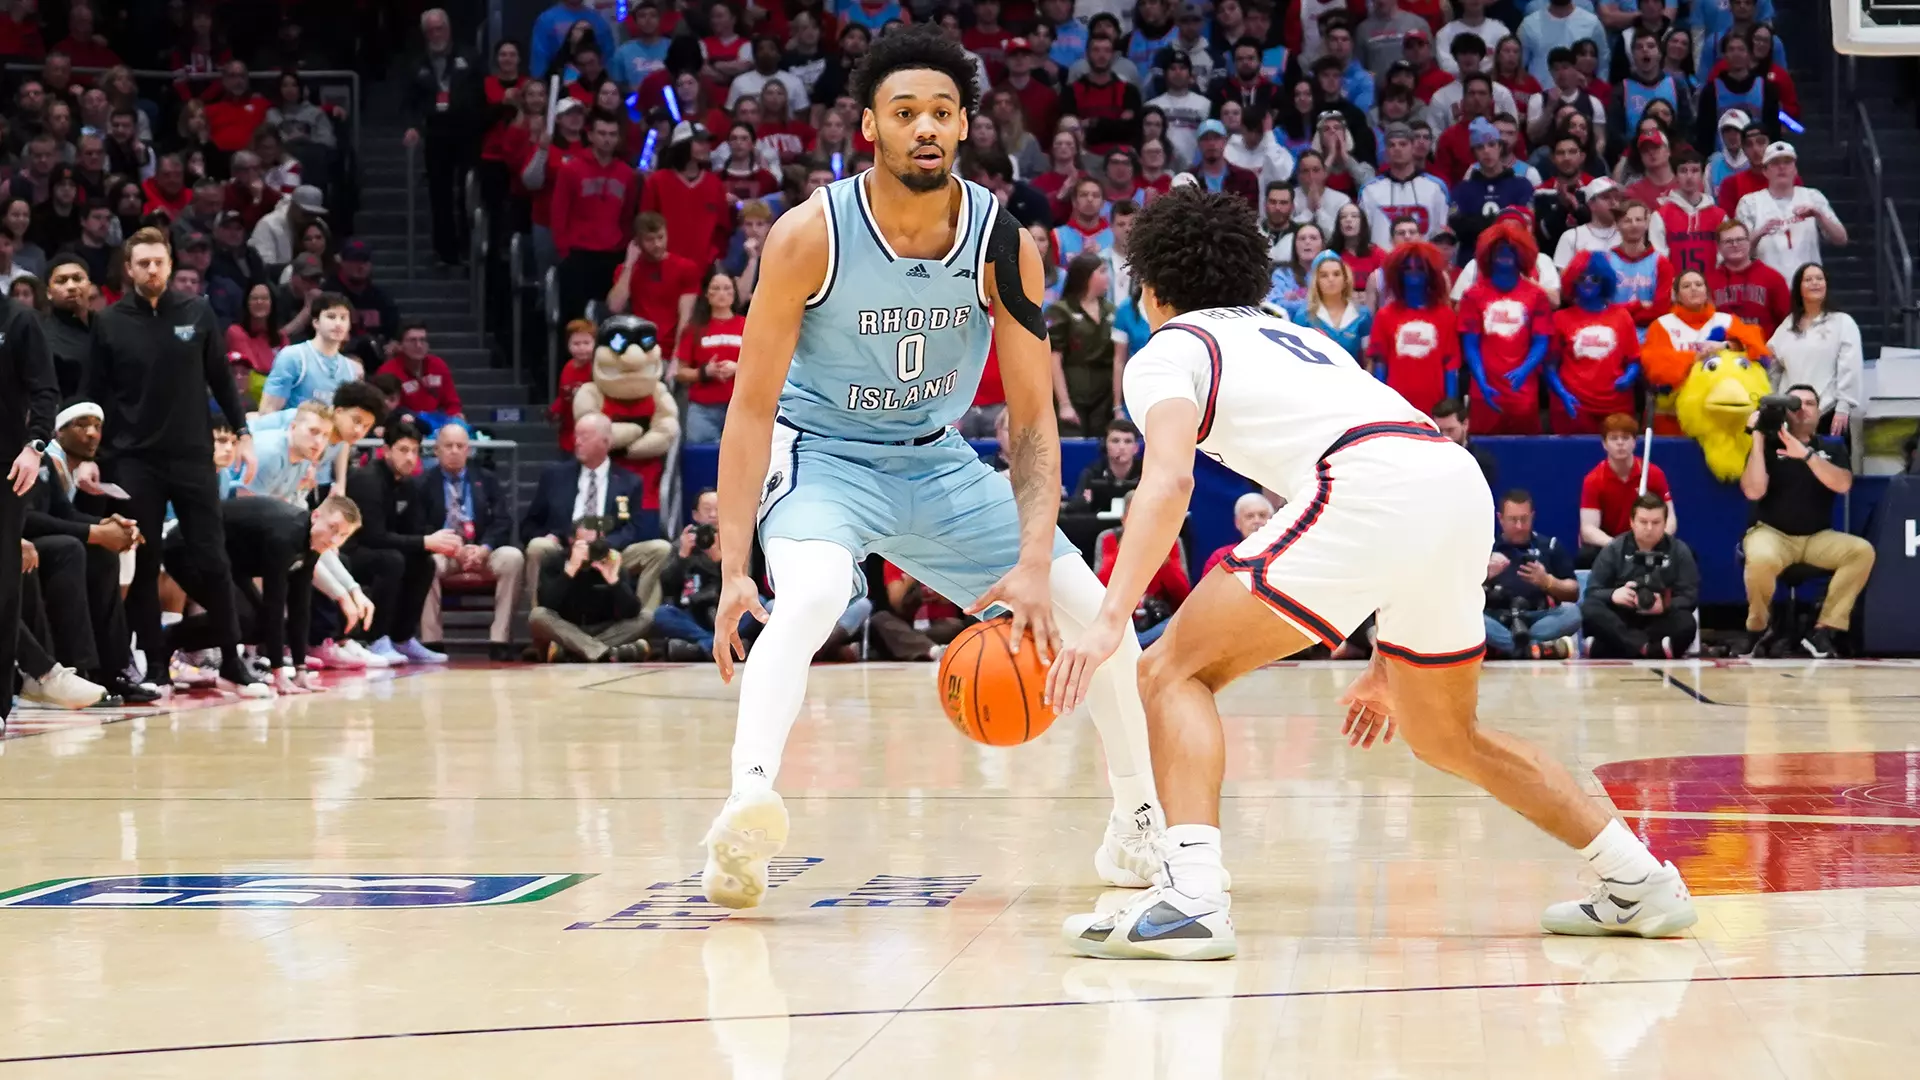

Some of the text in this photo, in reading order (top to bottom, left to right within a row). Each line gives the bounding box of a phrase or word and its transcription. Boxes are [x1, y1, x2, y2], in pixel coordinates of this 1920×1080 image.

[905, 271, 931, 279] adidas
[1681, 248, 1705, 273] 15
[859, 305, 971, 335] RHODE
[897, 332, 927, 383] 0
[1258, 327, 1339, 366] 0
[848, 369, 957, 410] ISLAND
